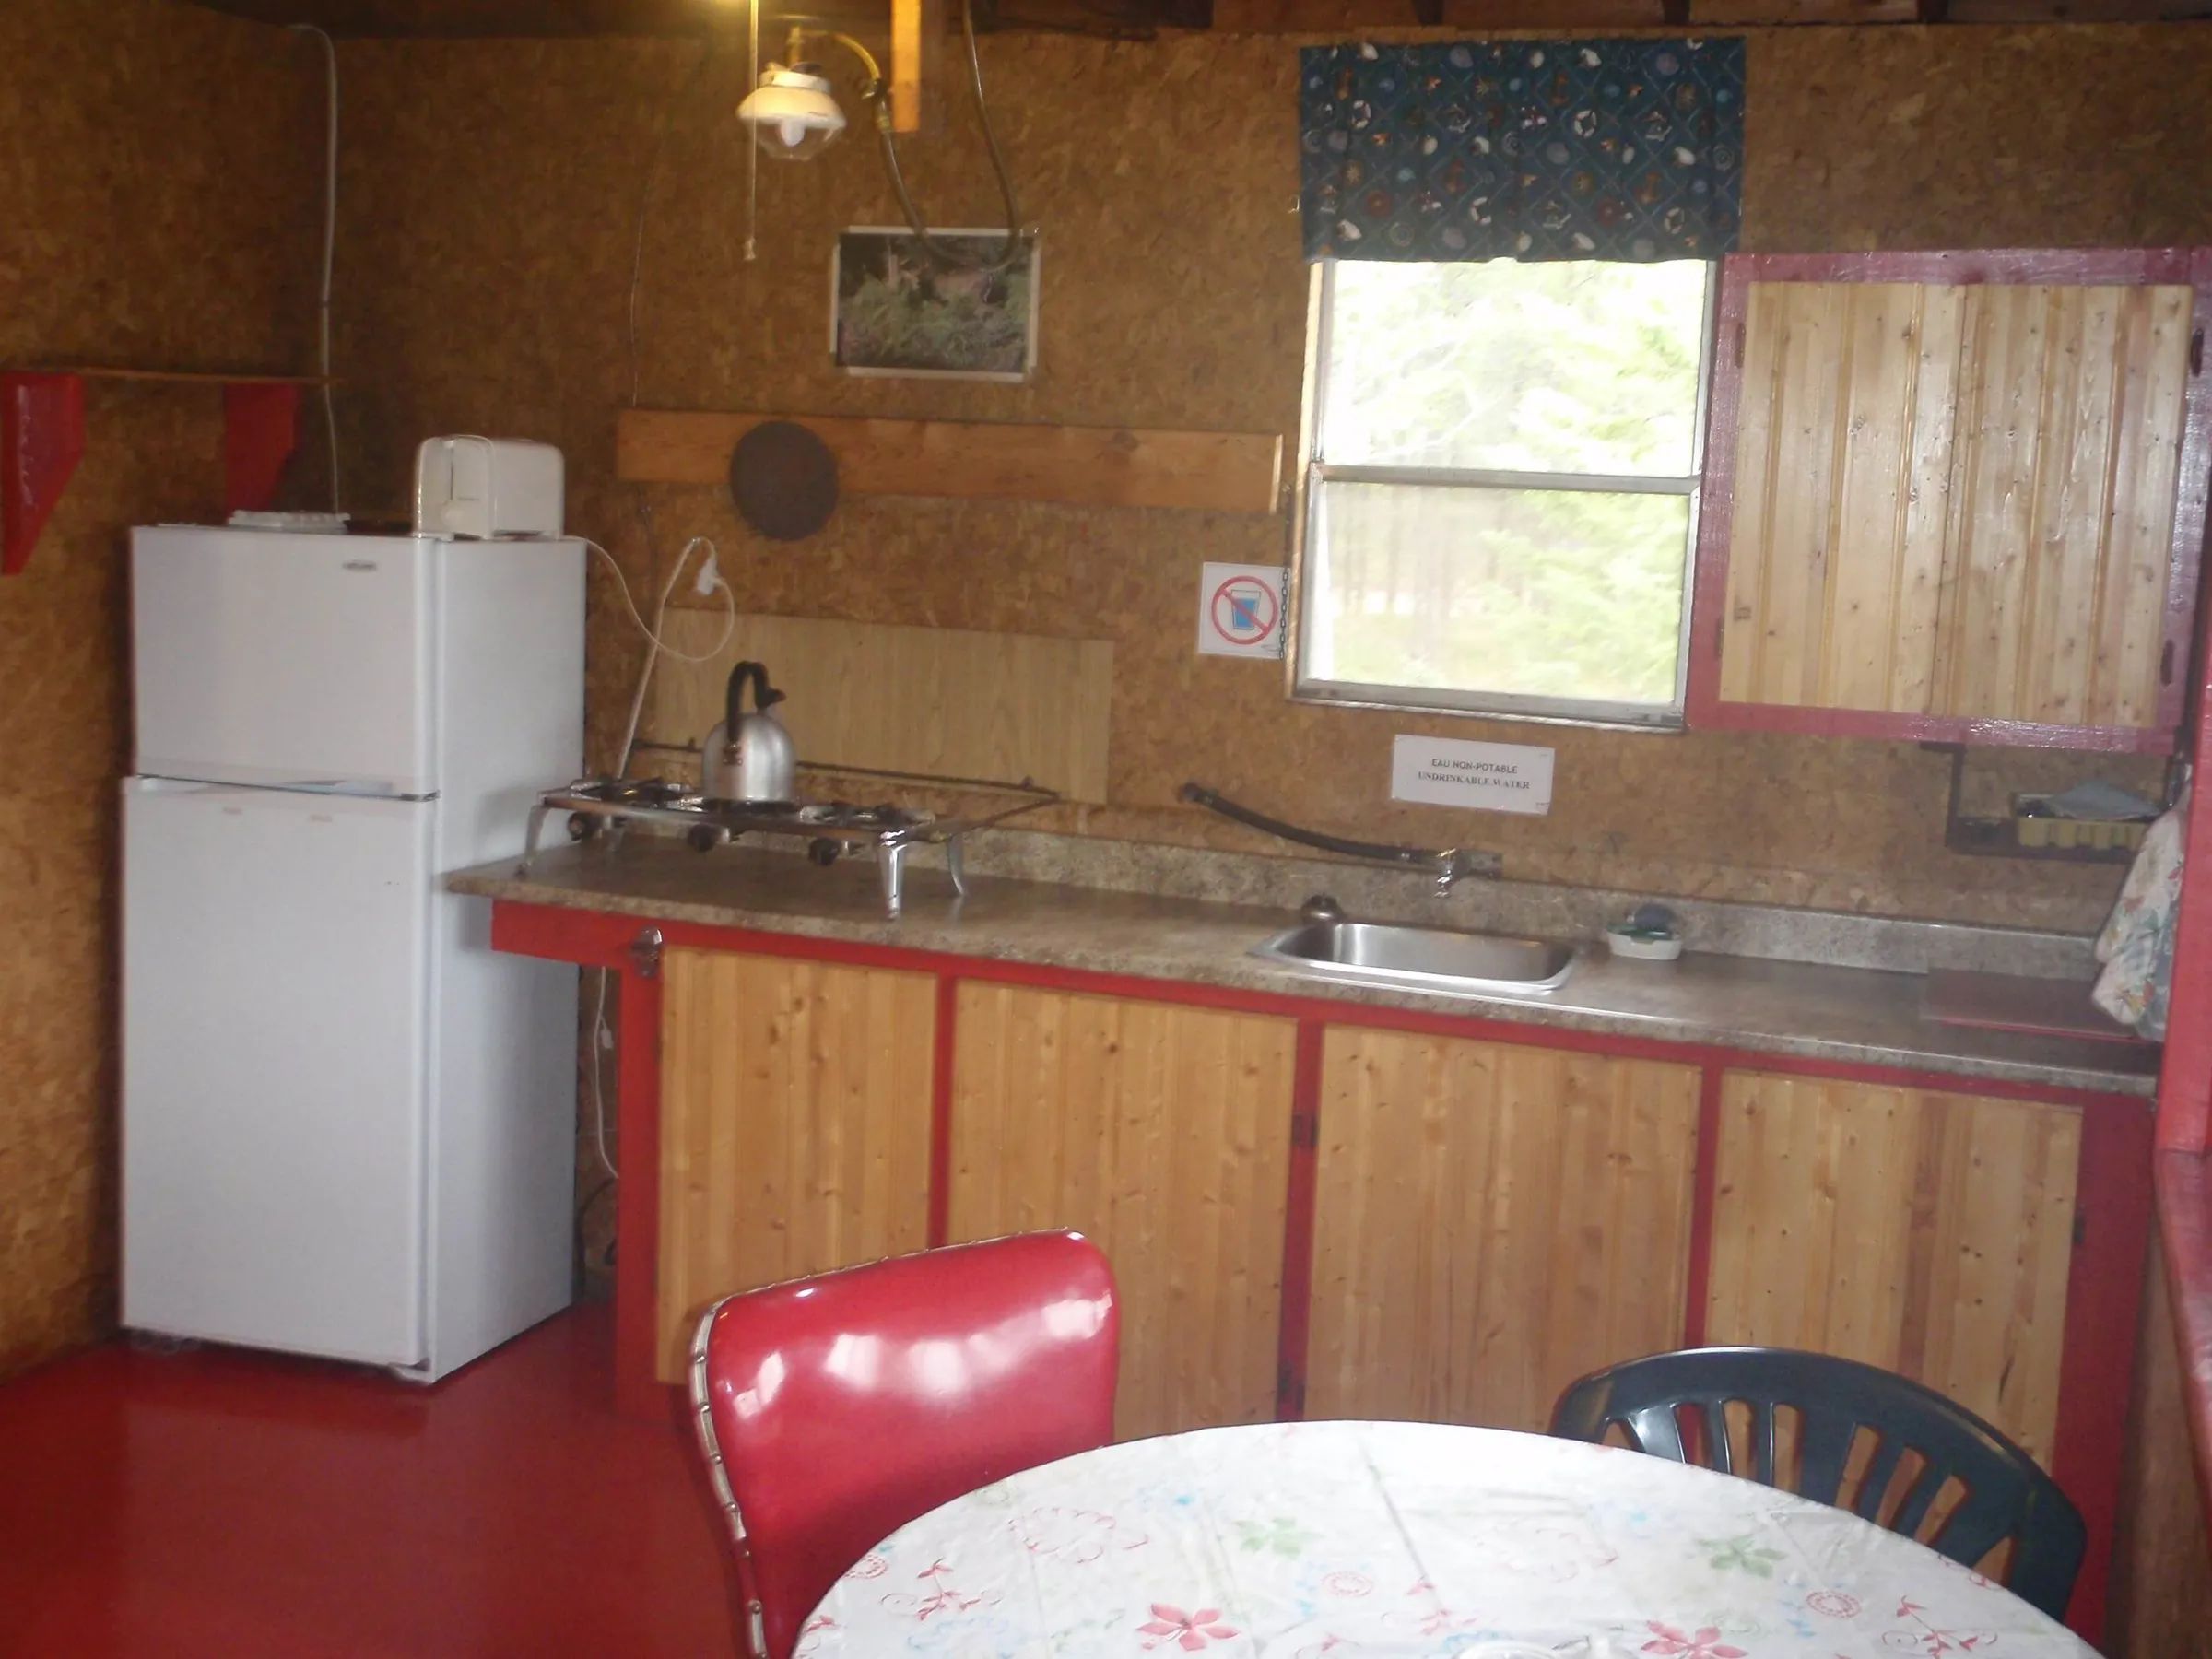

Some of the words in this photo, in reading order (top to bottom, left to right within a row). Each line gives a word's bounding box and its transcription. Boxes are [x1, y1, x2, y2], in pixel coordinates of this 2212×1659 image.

[1431, 759, 1451, 768] EAU
[1453, 760, 1518, 774] NON-POTABLE
[1418, 771, 1490, 785] UNDRINKABLE
[1492, 778, 1530, 790] WATER
